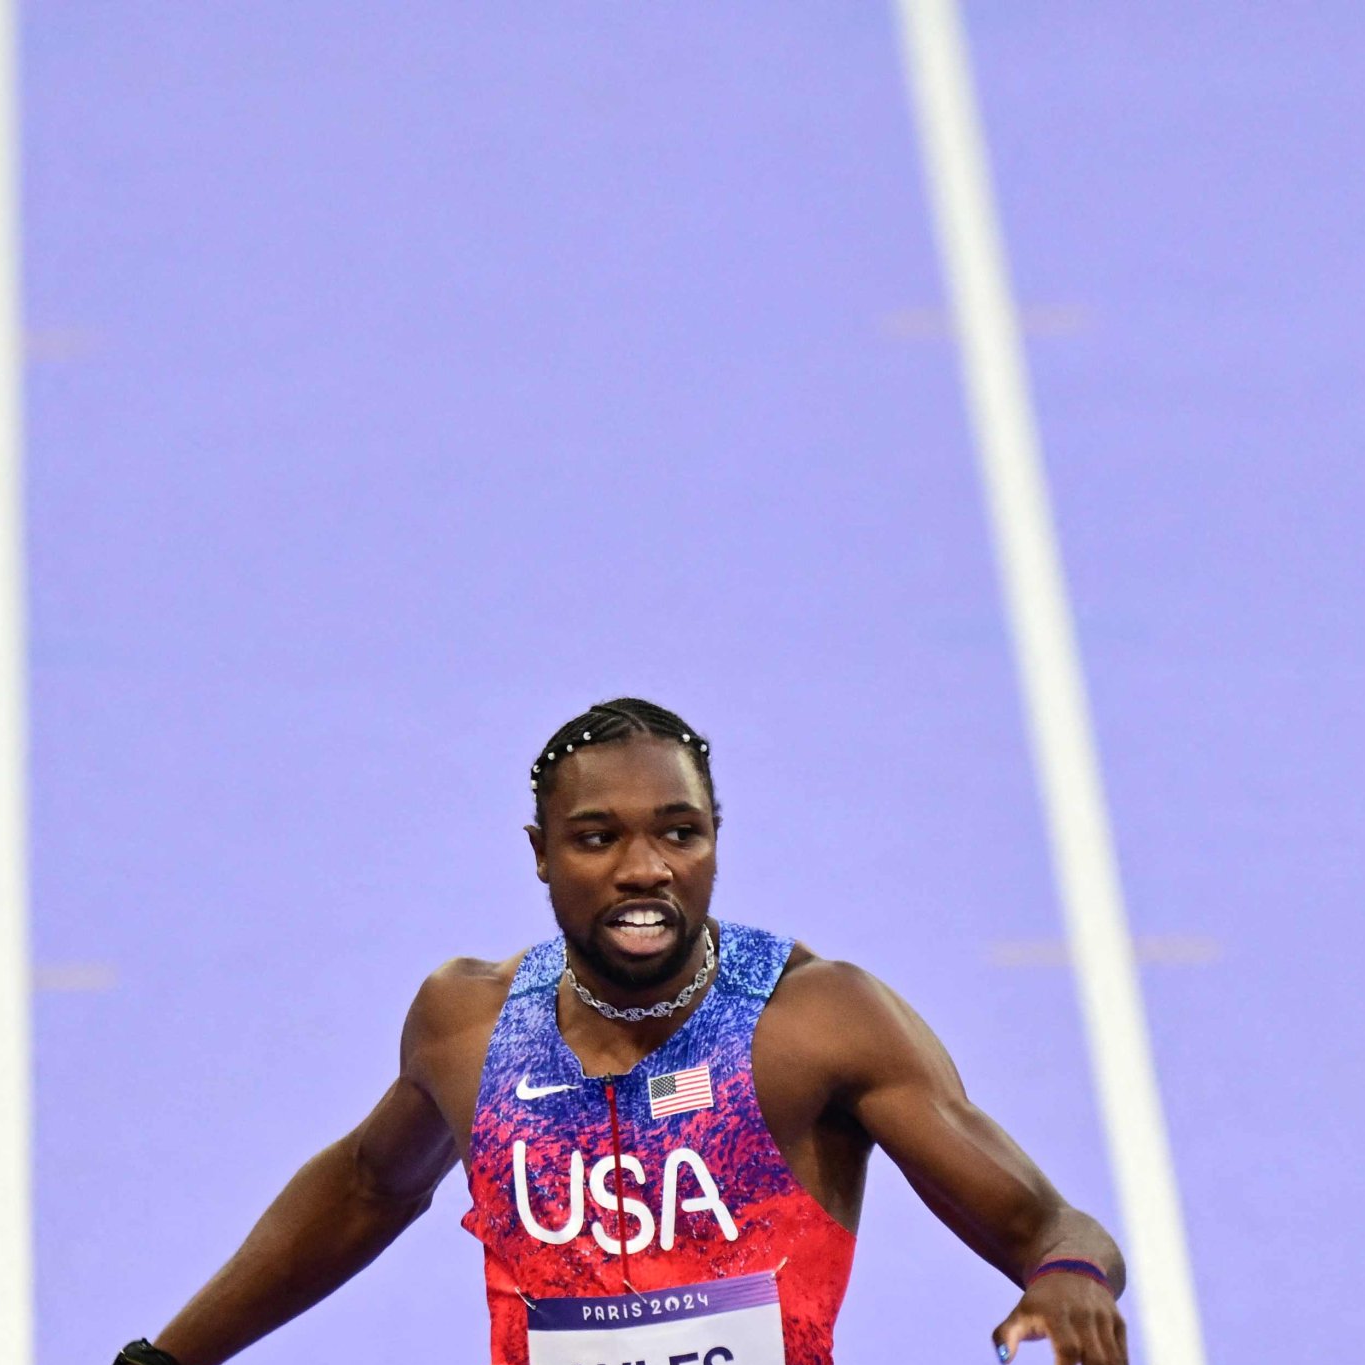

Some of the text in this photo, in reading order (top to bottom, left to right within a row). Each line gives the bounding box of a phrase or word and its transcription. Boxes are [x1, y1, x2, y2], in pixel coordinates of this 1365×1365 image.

[512, 1139, 739, 1255] USA
[582, 1292, 709, 1321] PARIS 2024
